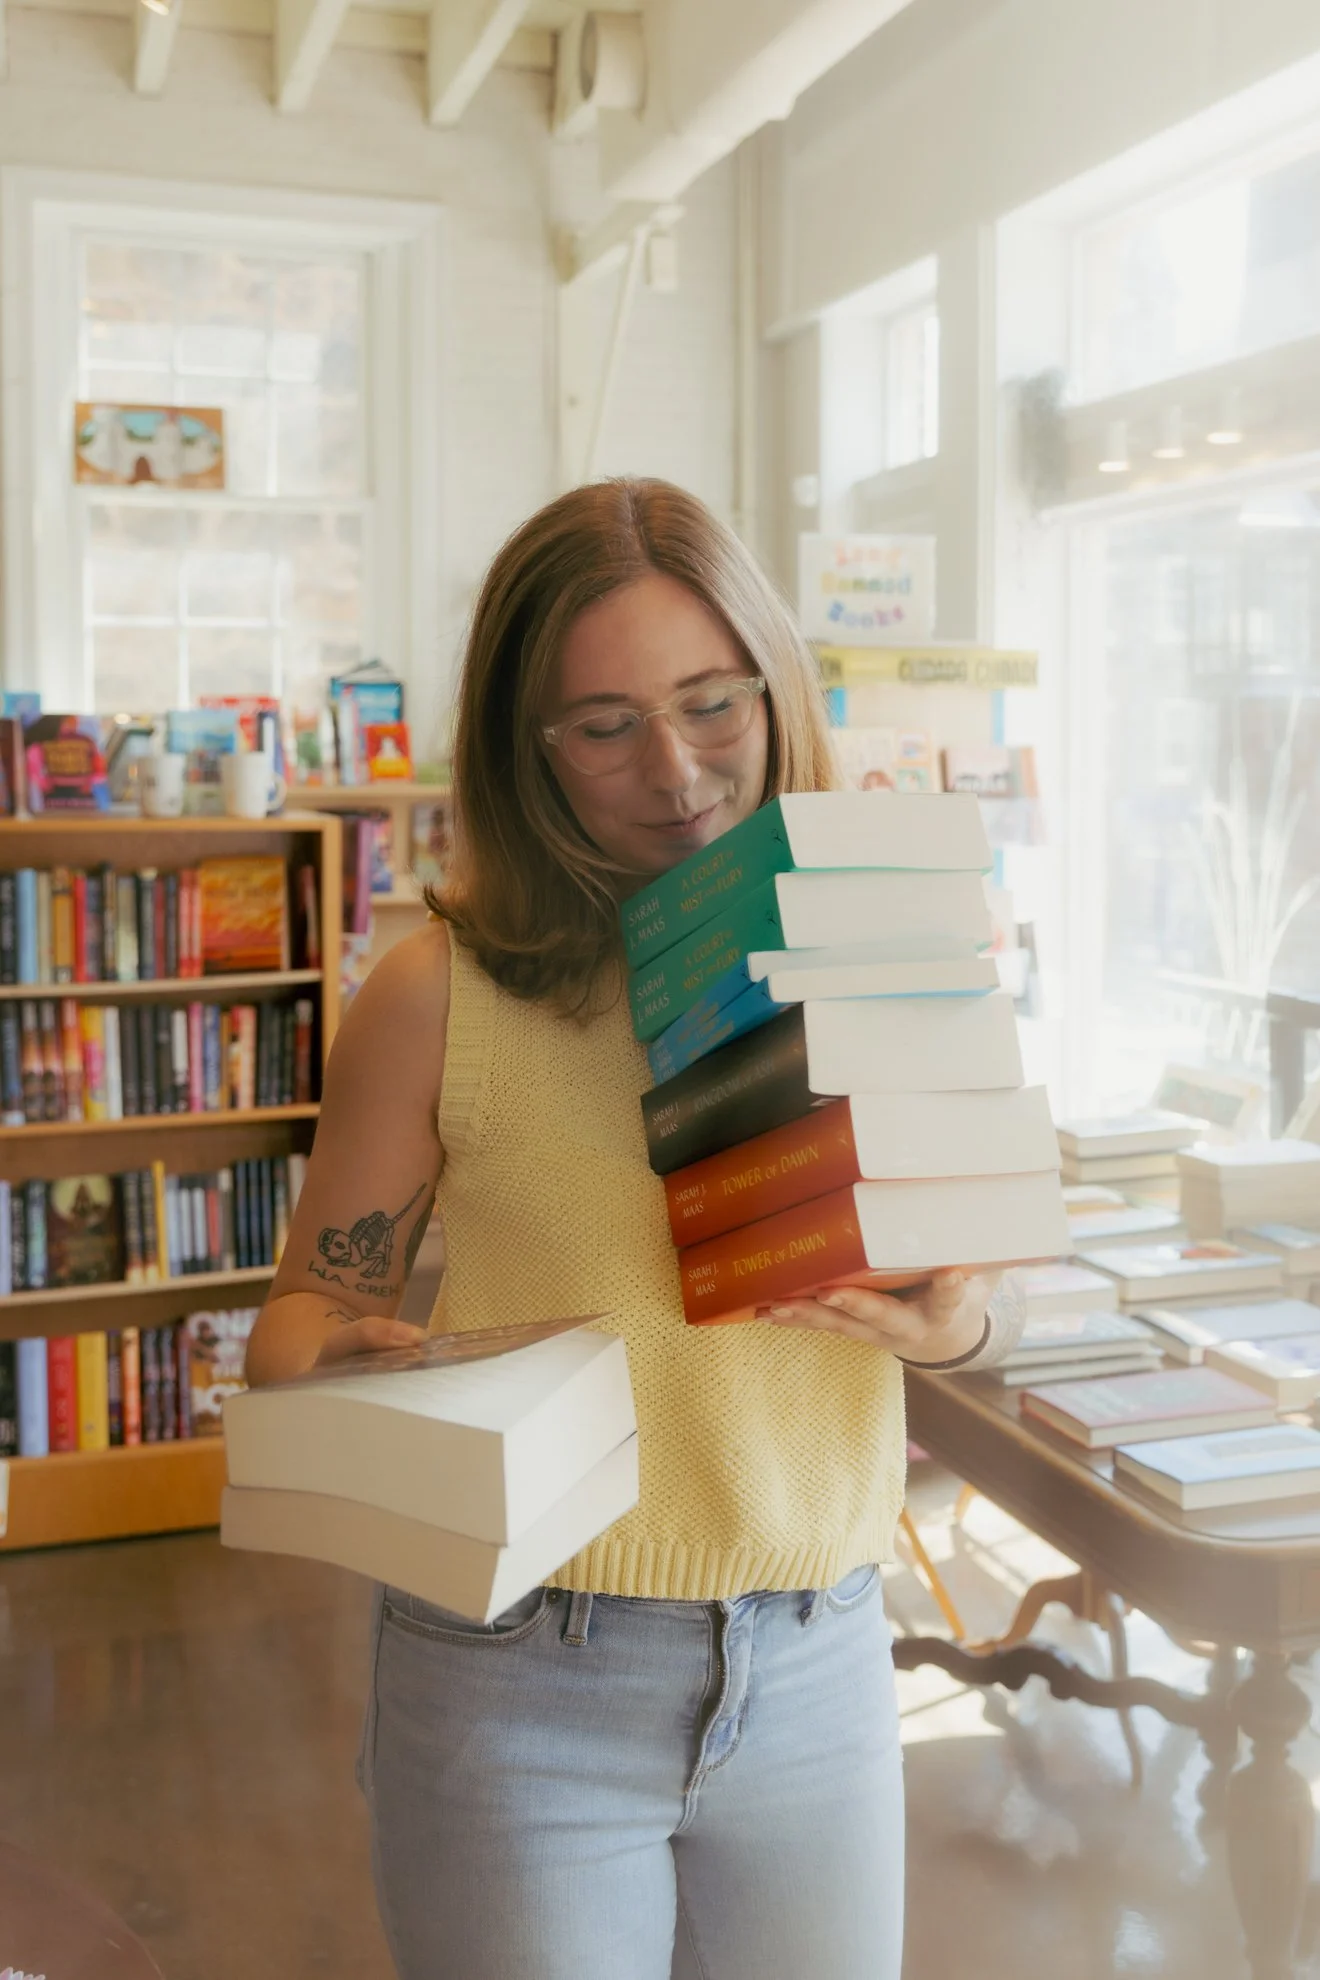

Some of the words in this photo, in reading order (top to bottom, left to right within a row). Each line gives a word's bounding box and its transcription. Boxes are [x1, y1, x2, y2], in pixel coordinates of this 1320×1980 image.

[691, 853, 725, 886] COURT
[680, 892, 703, 914] MIST
[715, 865, 743, 893] FURY
[629, 896, 660, 927] SARAH
[637, 916, 666, 943] MAAS
[692, 932, 726, 963] COURT
[715, 946, 741, 969] FURY
[636, 972, 665, 1002] SARAH
[644, 992, 670, 1018] MAAS
[652, 1102, 674, 1126] SARAH
[659, 1121, 679, 1139] MAAS
[722, 1166, 762, 1197] TOWER
[780, 1142, 819, 1174] DAWN
[675, 1185, 700, 1206] SARAH
[682, 1201, 704, 1220] MAAS
[732, 1249, 772, 1278] TOWER
[789, 1230, 827, 1259] DAWN
[688, 1263, 712, 1283] SARAH
[695, 1280, 717, 1297] MAAS
